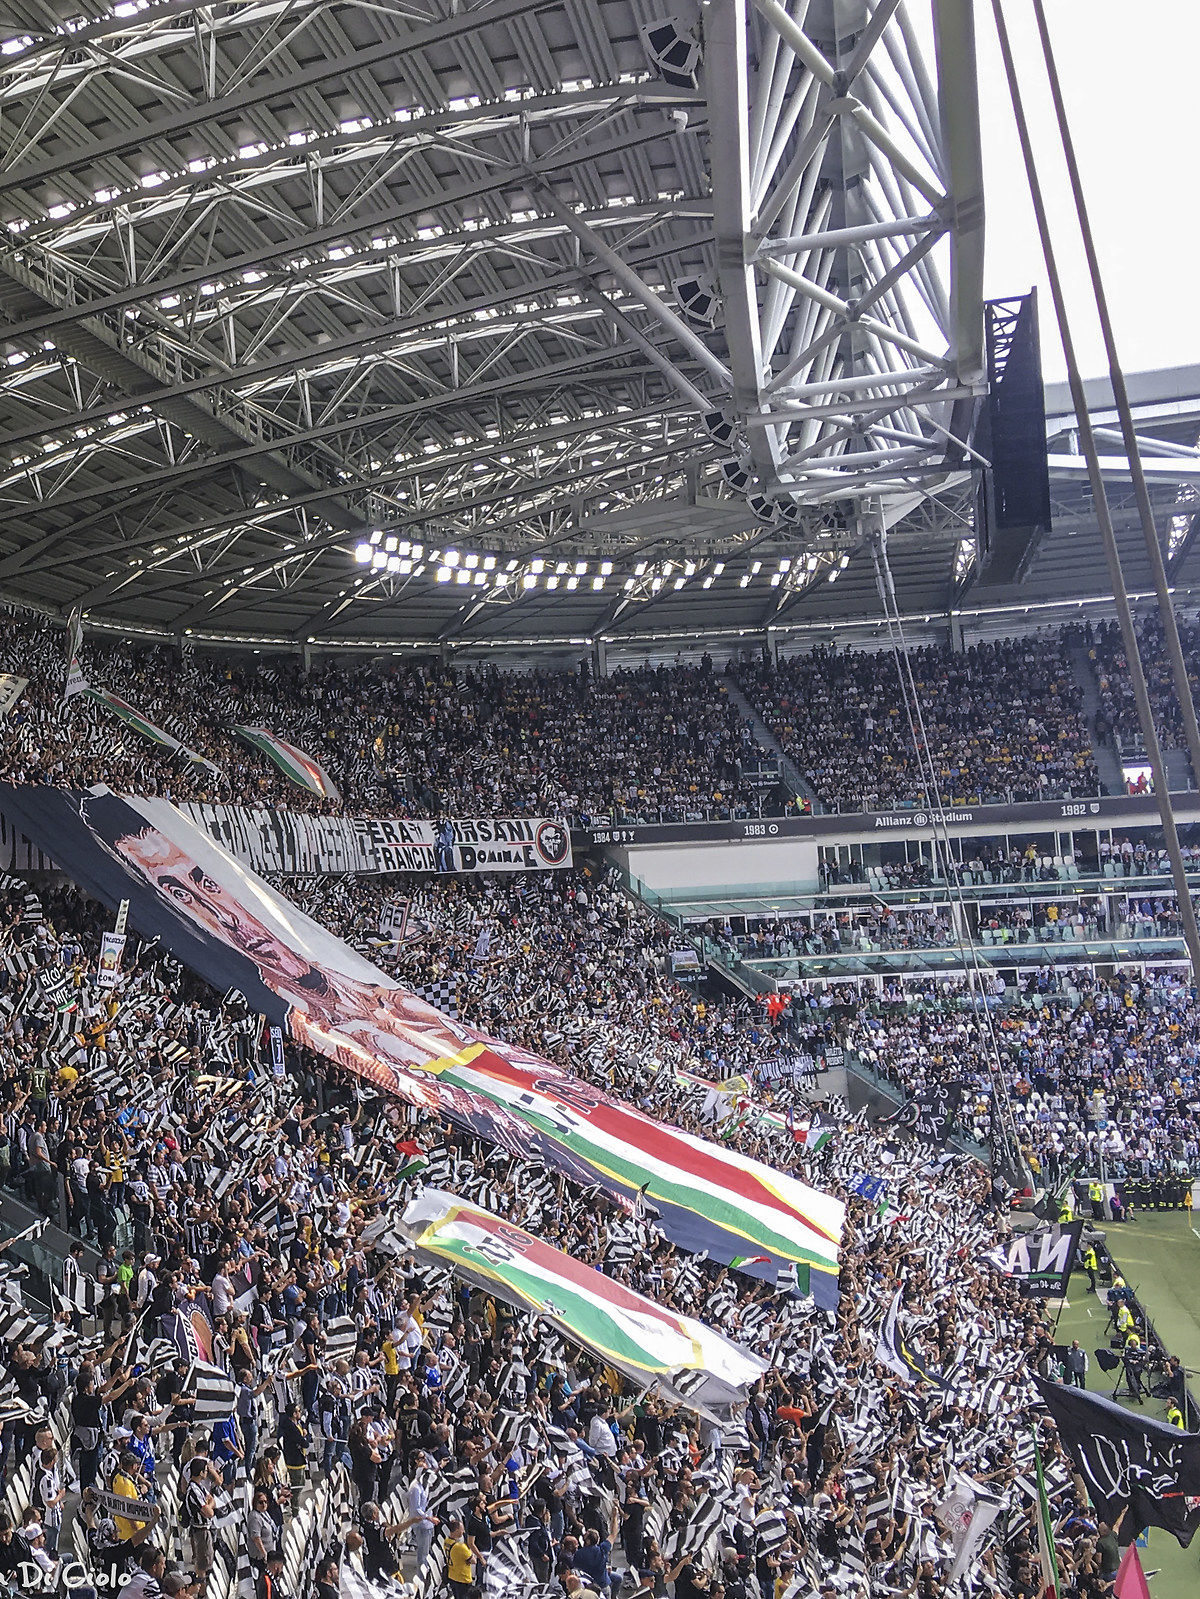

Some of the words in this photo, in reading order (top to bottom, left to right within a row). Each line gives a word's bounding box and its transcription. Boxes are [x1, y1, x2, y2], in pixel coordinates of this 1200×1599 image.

[1060, 804, 1087, 816] 1982
[875, 815, 912, 827] Allianz
[928, 812, 973, 823] Stadium
[744, 824, 766, 836] 1983
[592, 832, 611, 844] 1984
[34, 1073, 46, 1088] 17
